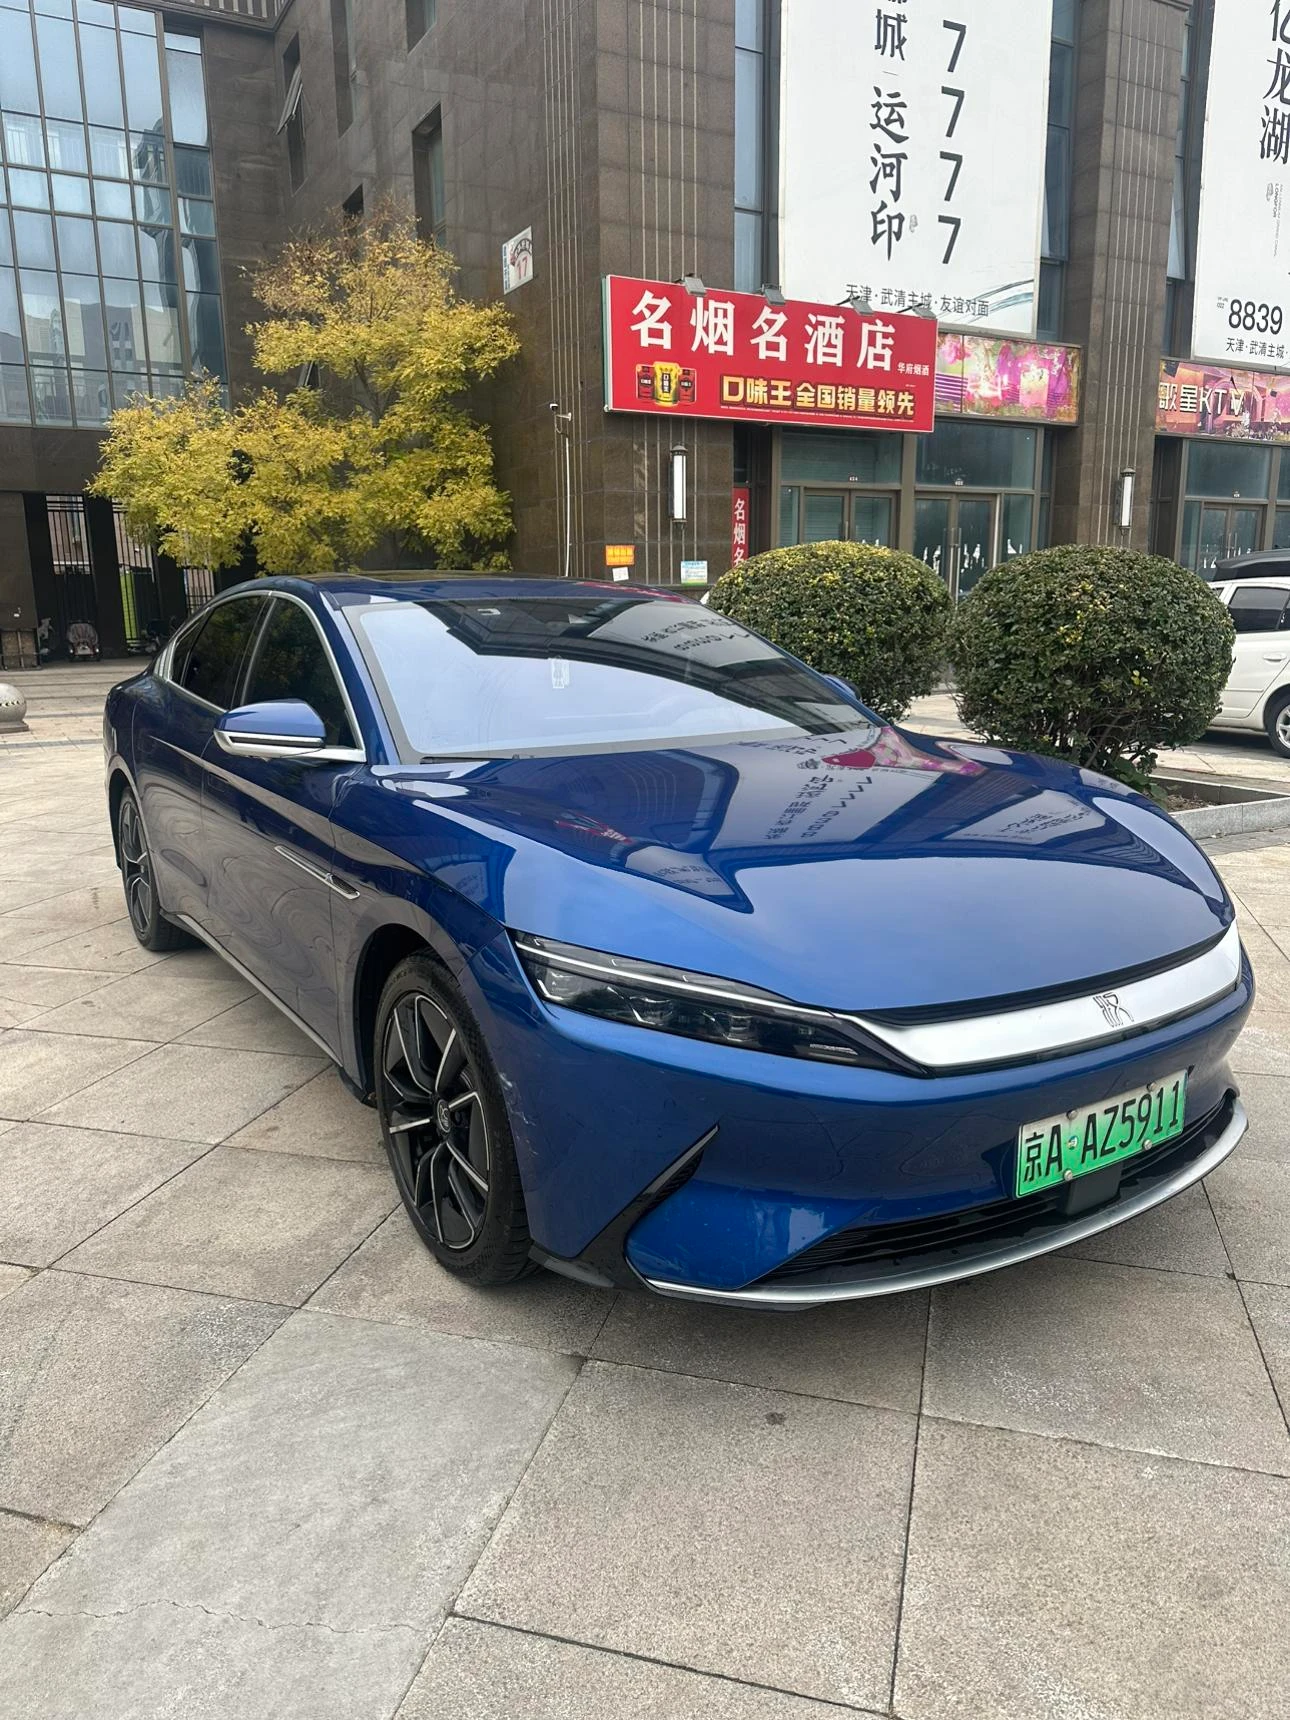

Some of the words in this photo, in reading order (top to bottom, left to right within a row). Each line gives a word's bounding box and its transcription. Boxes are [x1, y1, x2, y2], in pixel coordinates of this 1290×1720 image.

[938, 19, 967, 264] 7777
[630, 290, 896, 371] 名烟名酒店
[1228, 299, 1283, 335] 8839
[1024, 1124, 1062, 1182] 京A
[1081, 1080, 1180, 1164] AZ5911
